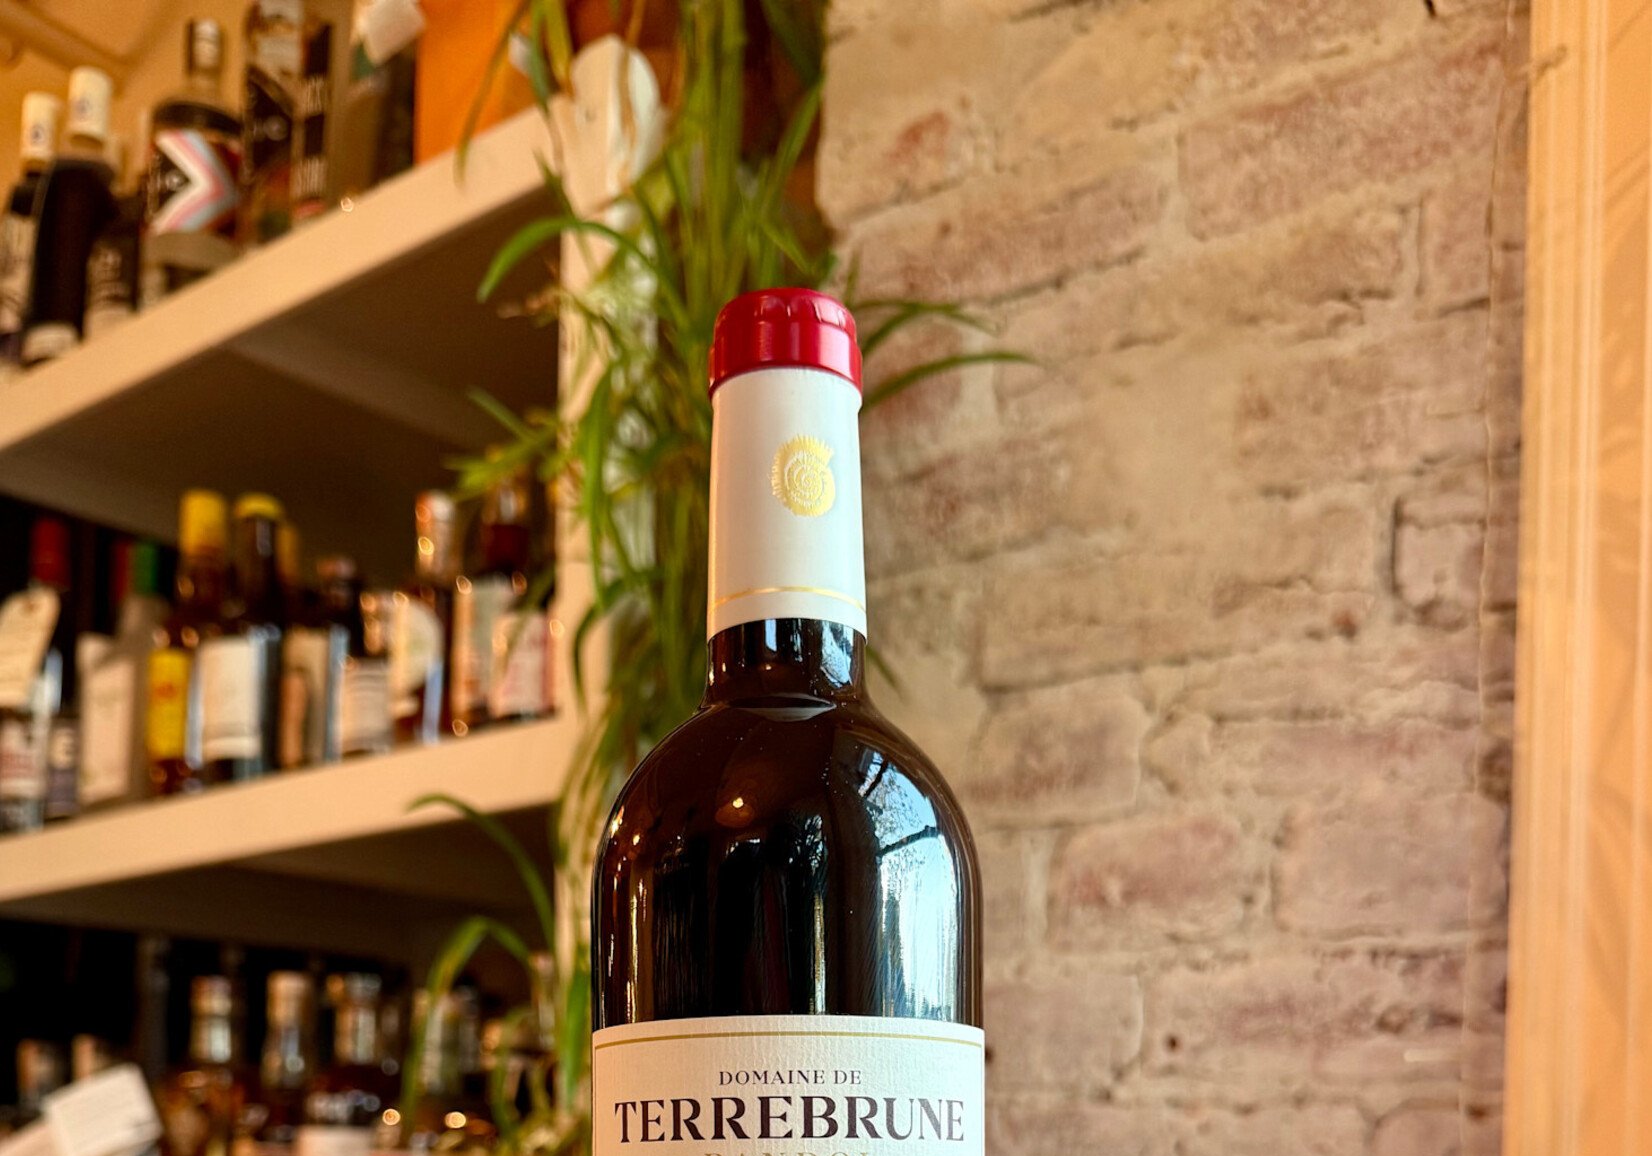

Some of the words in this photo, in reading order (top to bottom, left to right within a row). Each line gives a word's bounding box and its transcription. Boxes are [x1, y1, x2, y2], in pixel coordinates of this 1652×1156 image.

[719, 1069, 826, 1086] DOMAINE
[834, 1069, 862, 1085] DE
[614, 1095, 965, 1143] TERREBRUNE
